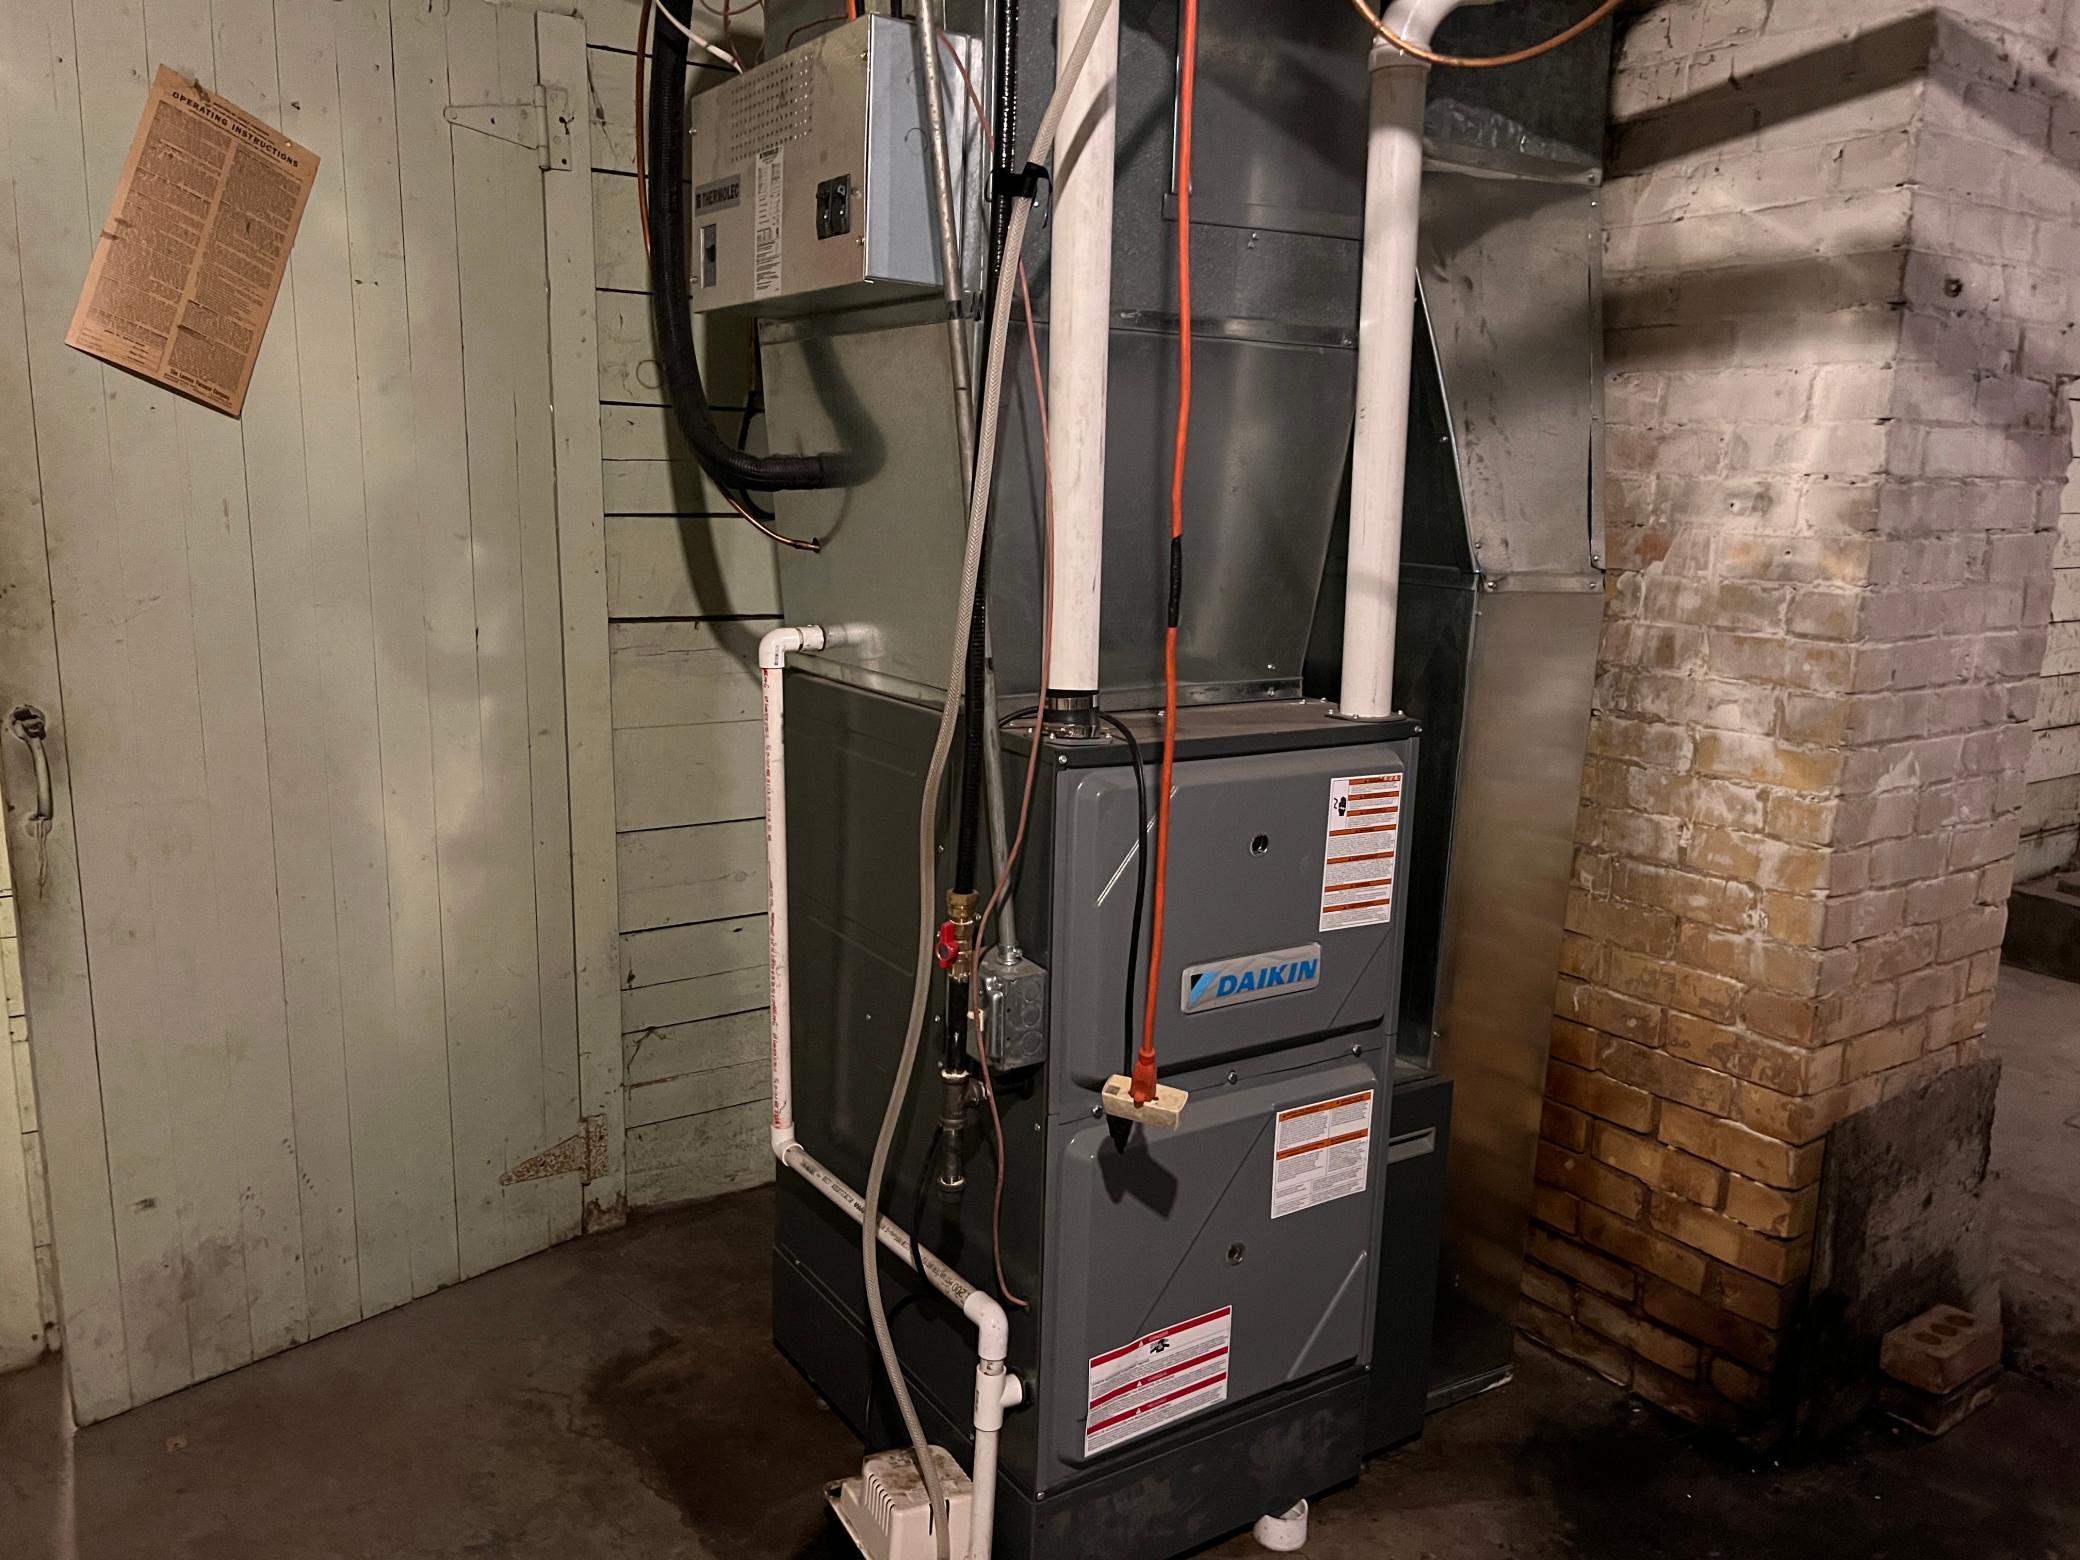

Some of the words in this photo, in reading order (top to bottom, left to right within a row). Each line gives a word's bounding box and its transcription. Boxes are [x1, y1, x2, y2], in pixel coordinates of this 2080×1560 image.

[172, 91, 228, 127] OPERATING
[231, 123, 299, 169] INSTRUCTIONS
[702, 182, 740, 206] THERMOLEC
[1216, 959, 1319, 997] DAIKIN
